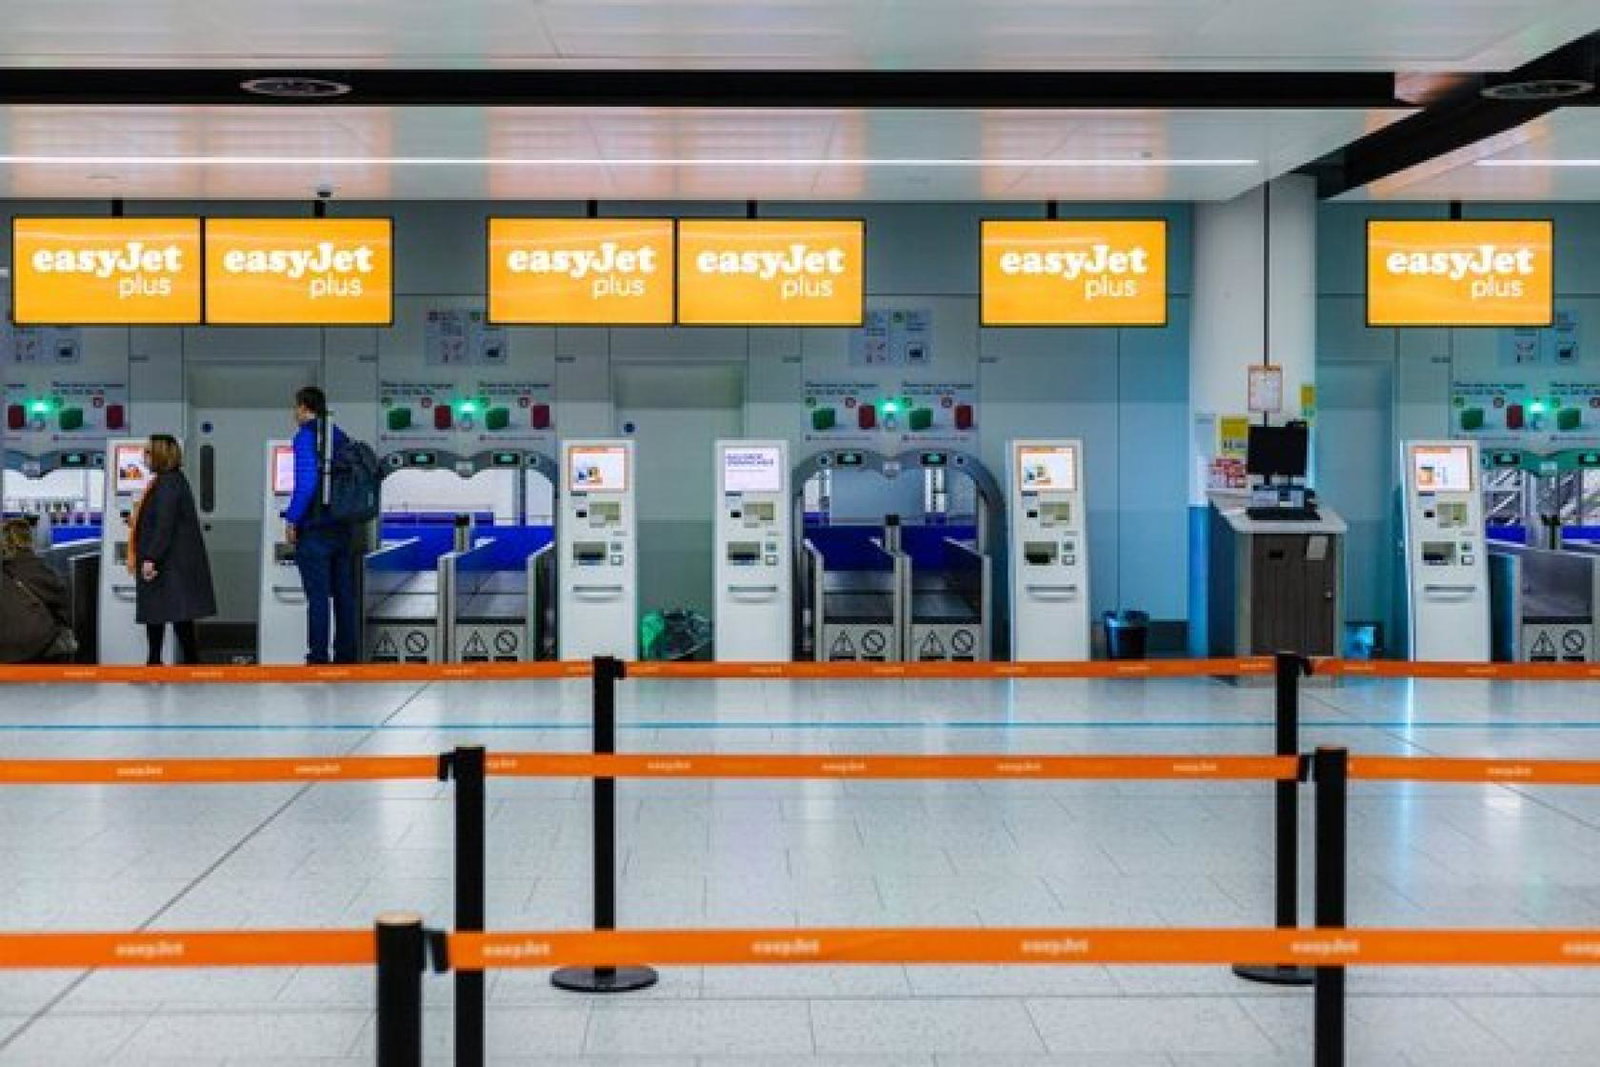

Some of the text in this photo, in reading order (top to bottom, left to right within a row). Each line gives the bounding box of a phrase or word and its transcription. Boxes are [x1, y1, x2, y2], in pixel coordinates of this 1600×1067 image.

[32, 242, 182, 276] easyJet
[224, 242, 372, 277] easyJet
[507, 242, 656, 276] easyJet
[696, 242, 845, 276] easyJet
[999, 244, 1148, 278] easyJet
[1386, 244, 1534, 278] easyJet
[119, 274, 172, 298] plus
[309, 274, 363, 299] plus
[592, 274, 645, 299] plus
[780, 274, 834, 299] plus
[1083, 275, 1137, 300] plus
[1470, 275, 1523, 300] plus
